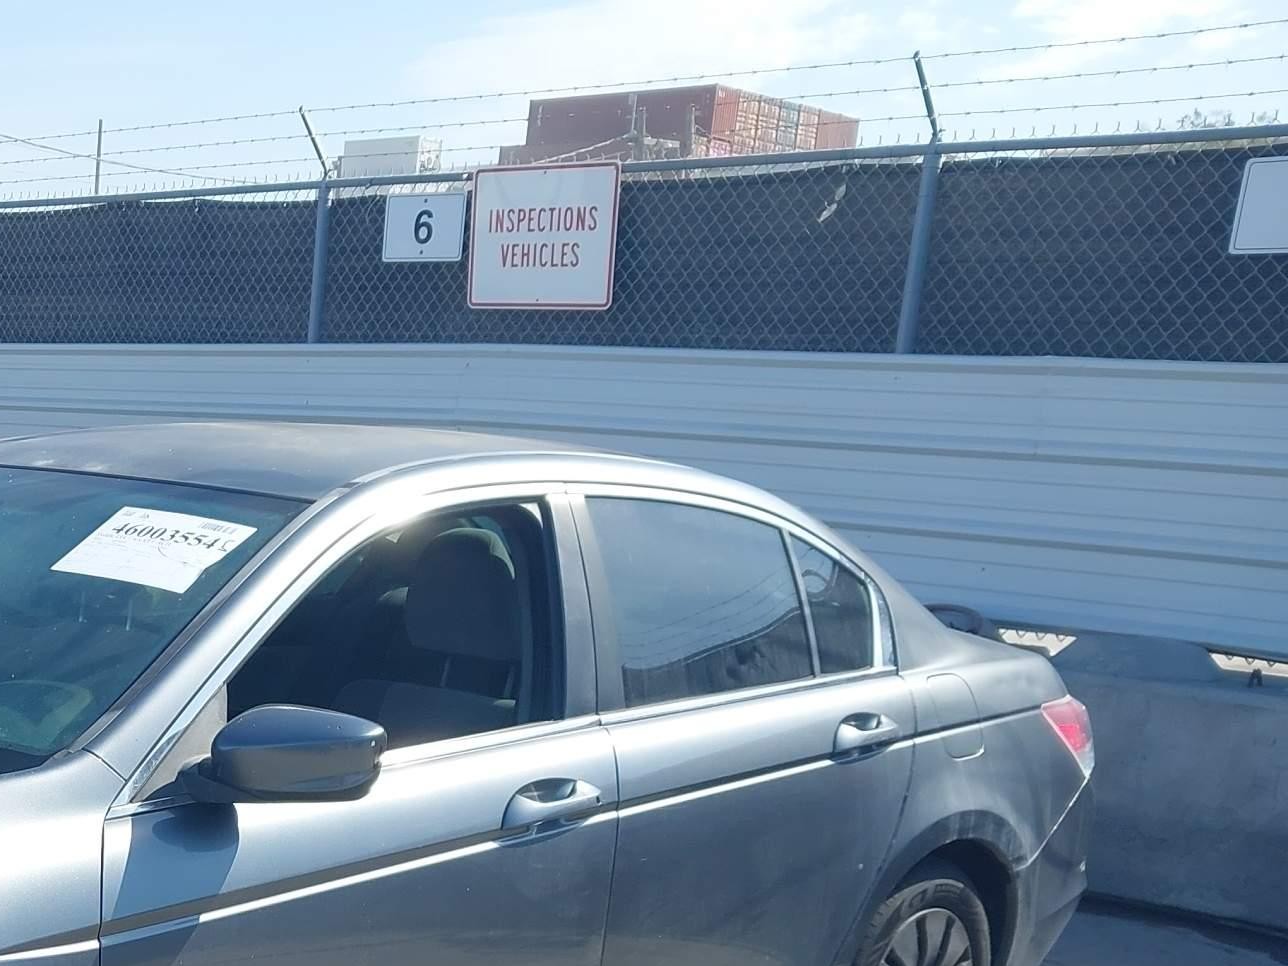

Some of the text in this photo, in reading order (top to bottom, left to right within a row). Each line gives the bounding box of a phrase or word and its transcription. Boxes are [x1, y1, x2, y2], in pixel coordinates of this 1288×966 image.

[413, 209, 434, 245] 6
[488, 206, 599, 234] INSPECTIONS
[500, 242, 581, 268] VEHICLES
[112, 521, 223, 550] 46003554
